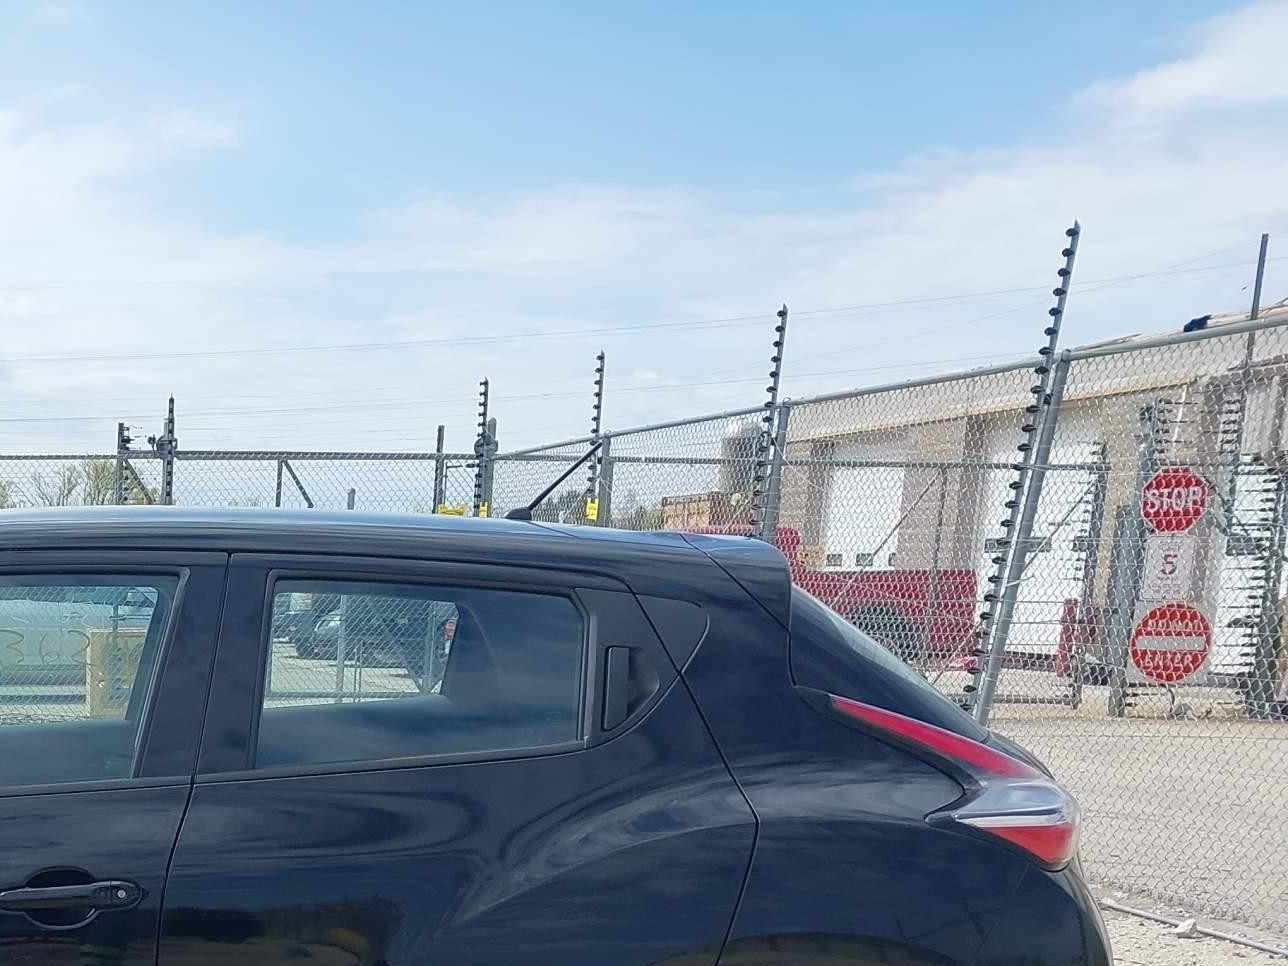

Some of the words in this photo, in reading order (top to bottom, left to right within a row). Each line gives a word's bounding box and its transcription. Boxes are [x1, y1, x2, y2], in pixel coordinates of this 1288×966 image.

[1145, 486, 1203, 512] STOP
[1160, 554, 1178, 575] 5
[1144, 653, 1193, 668] ENTER
